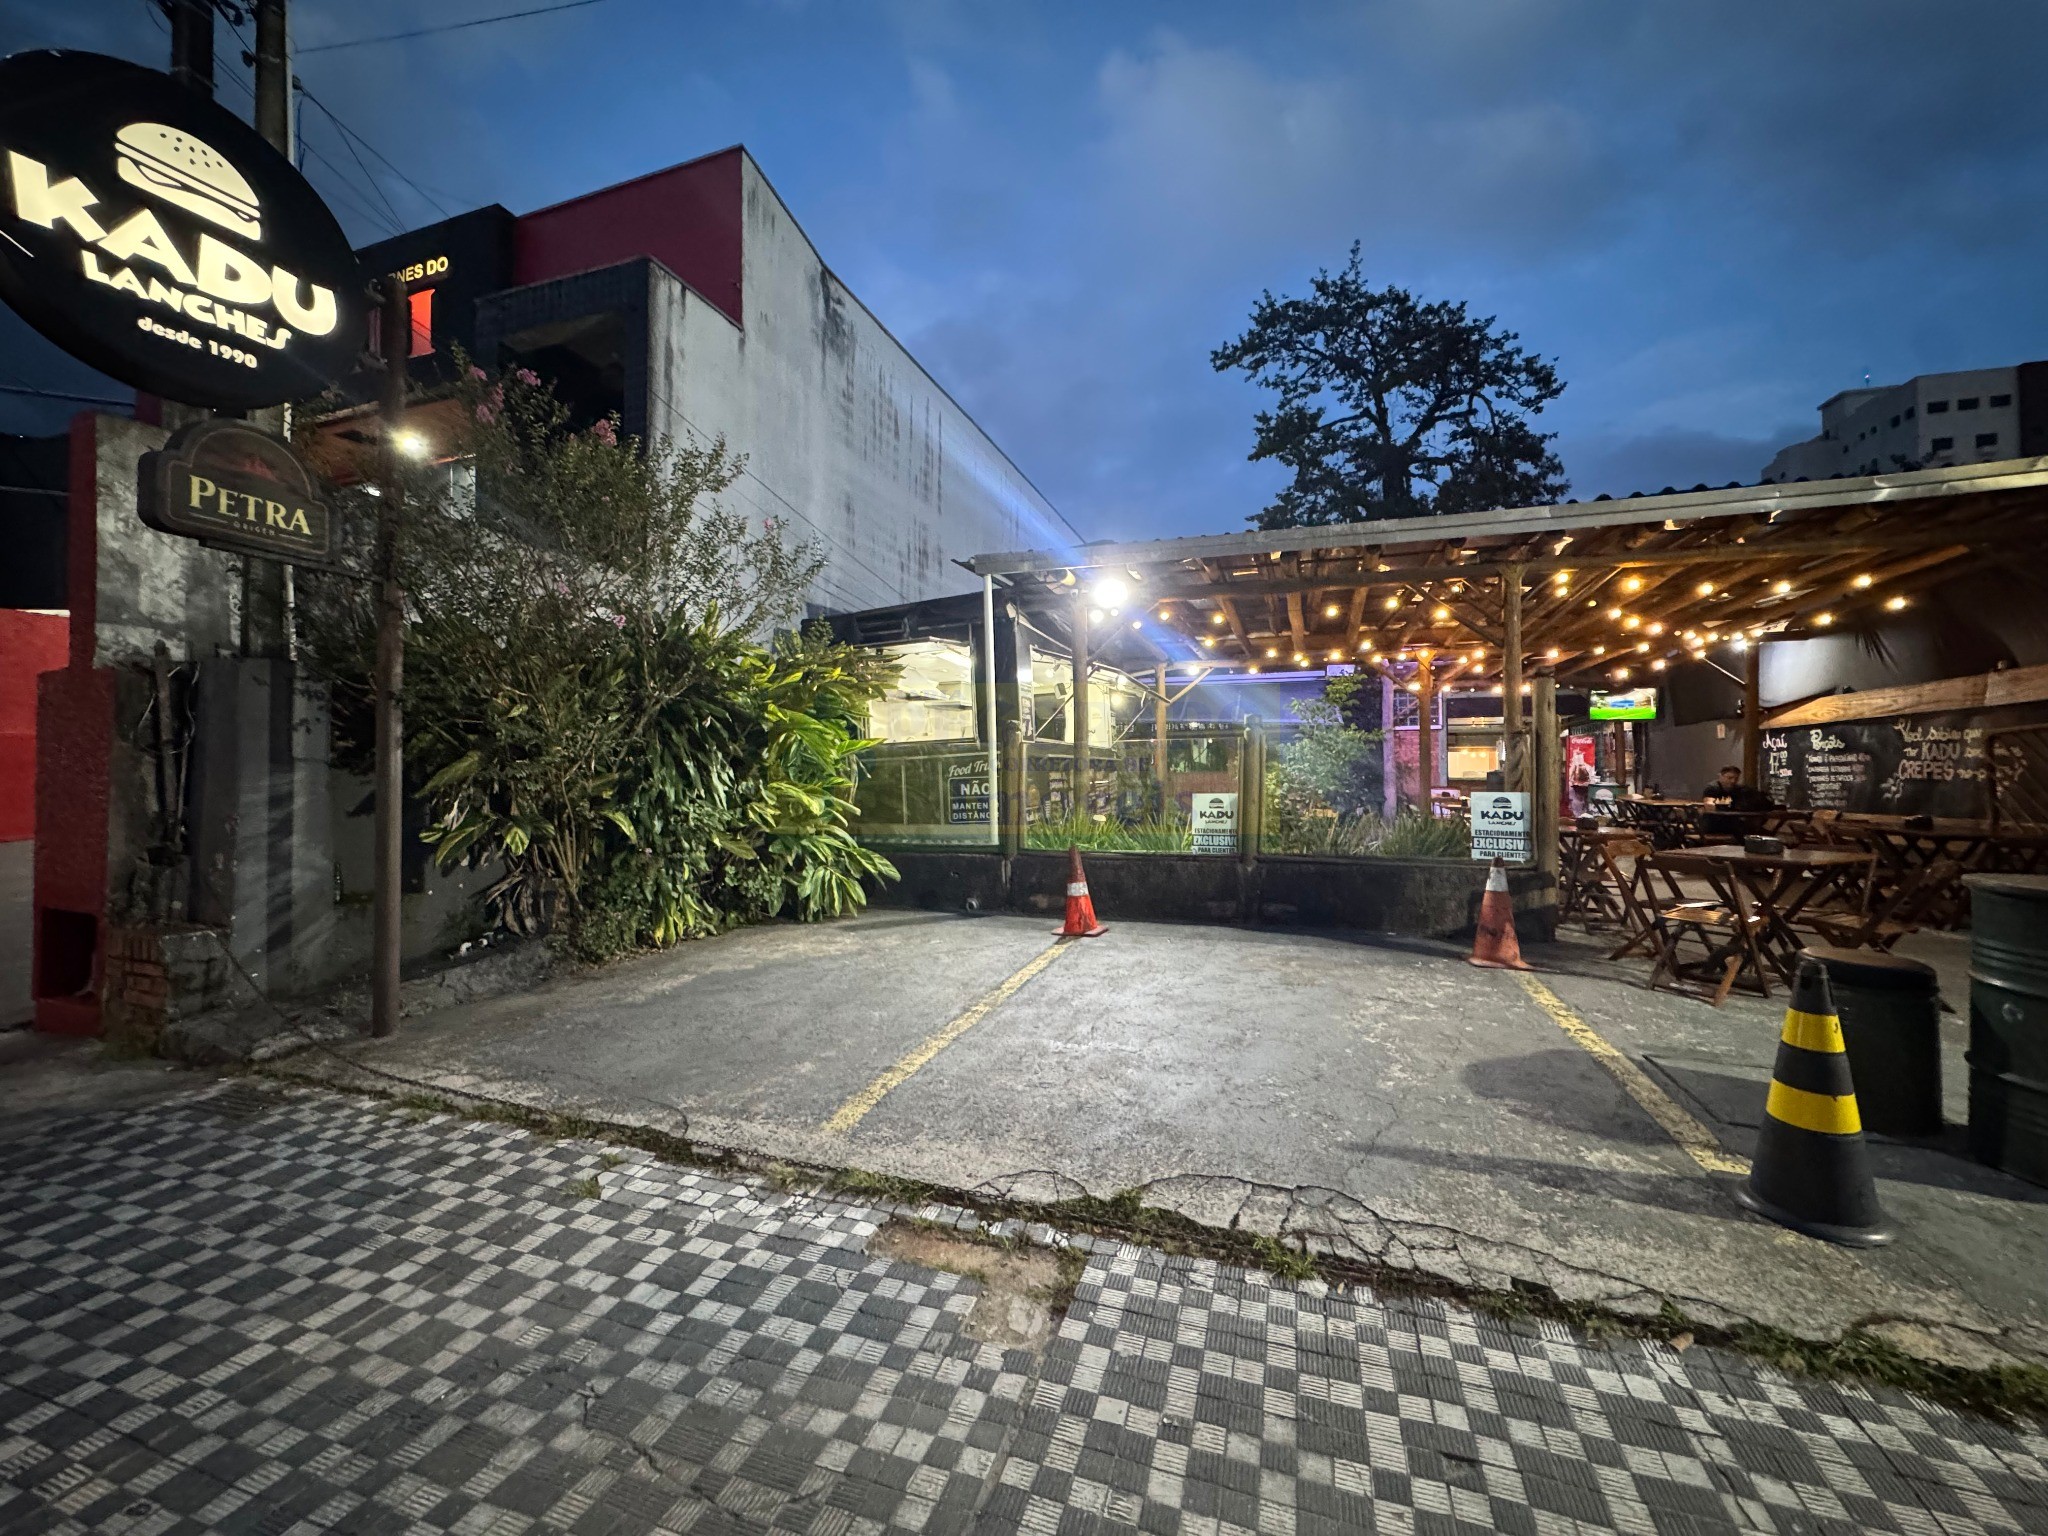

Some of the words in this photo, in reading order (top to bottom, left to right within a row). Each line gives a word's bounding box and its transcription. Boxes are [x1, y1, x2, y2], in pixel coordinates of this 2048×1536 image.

[9, 149, 339, 336] KADU
[427, 256, 449, 275] DO
[82, 249, 293, 351] LANCHES
[137, 316, 202, 353] desde
[209, 338, 259, 369] 1990
[189, 474, 313, 536] PETRA
[1921, 742, 1961, 760] KADU
[948, 763, 972, 777] Food
[974, 760, 1001, 773] Tru
[1898, 759, 1954, 780] CREPES
[952, 802, 999, 810] MANTEN
[1199, 811, 1234, 819] KADU
[1480, 810, 1525, 820] KADU
